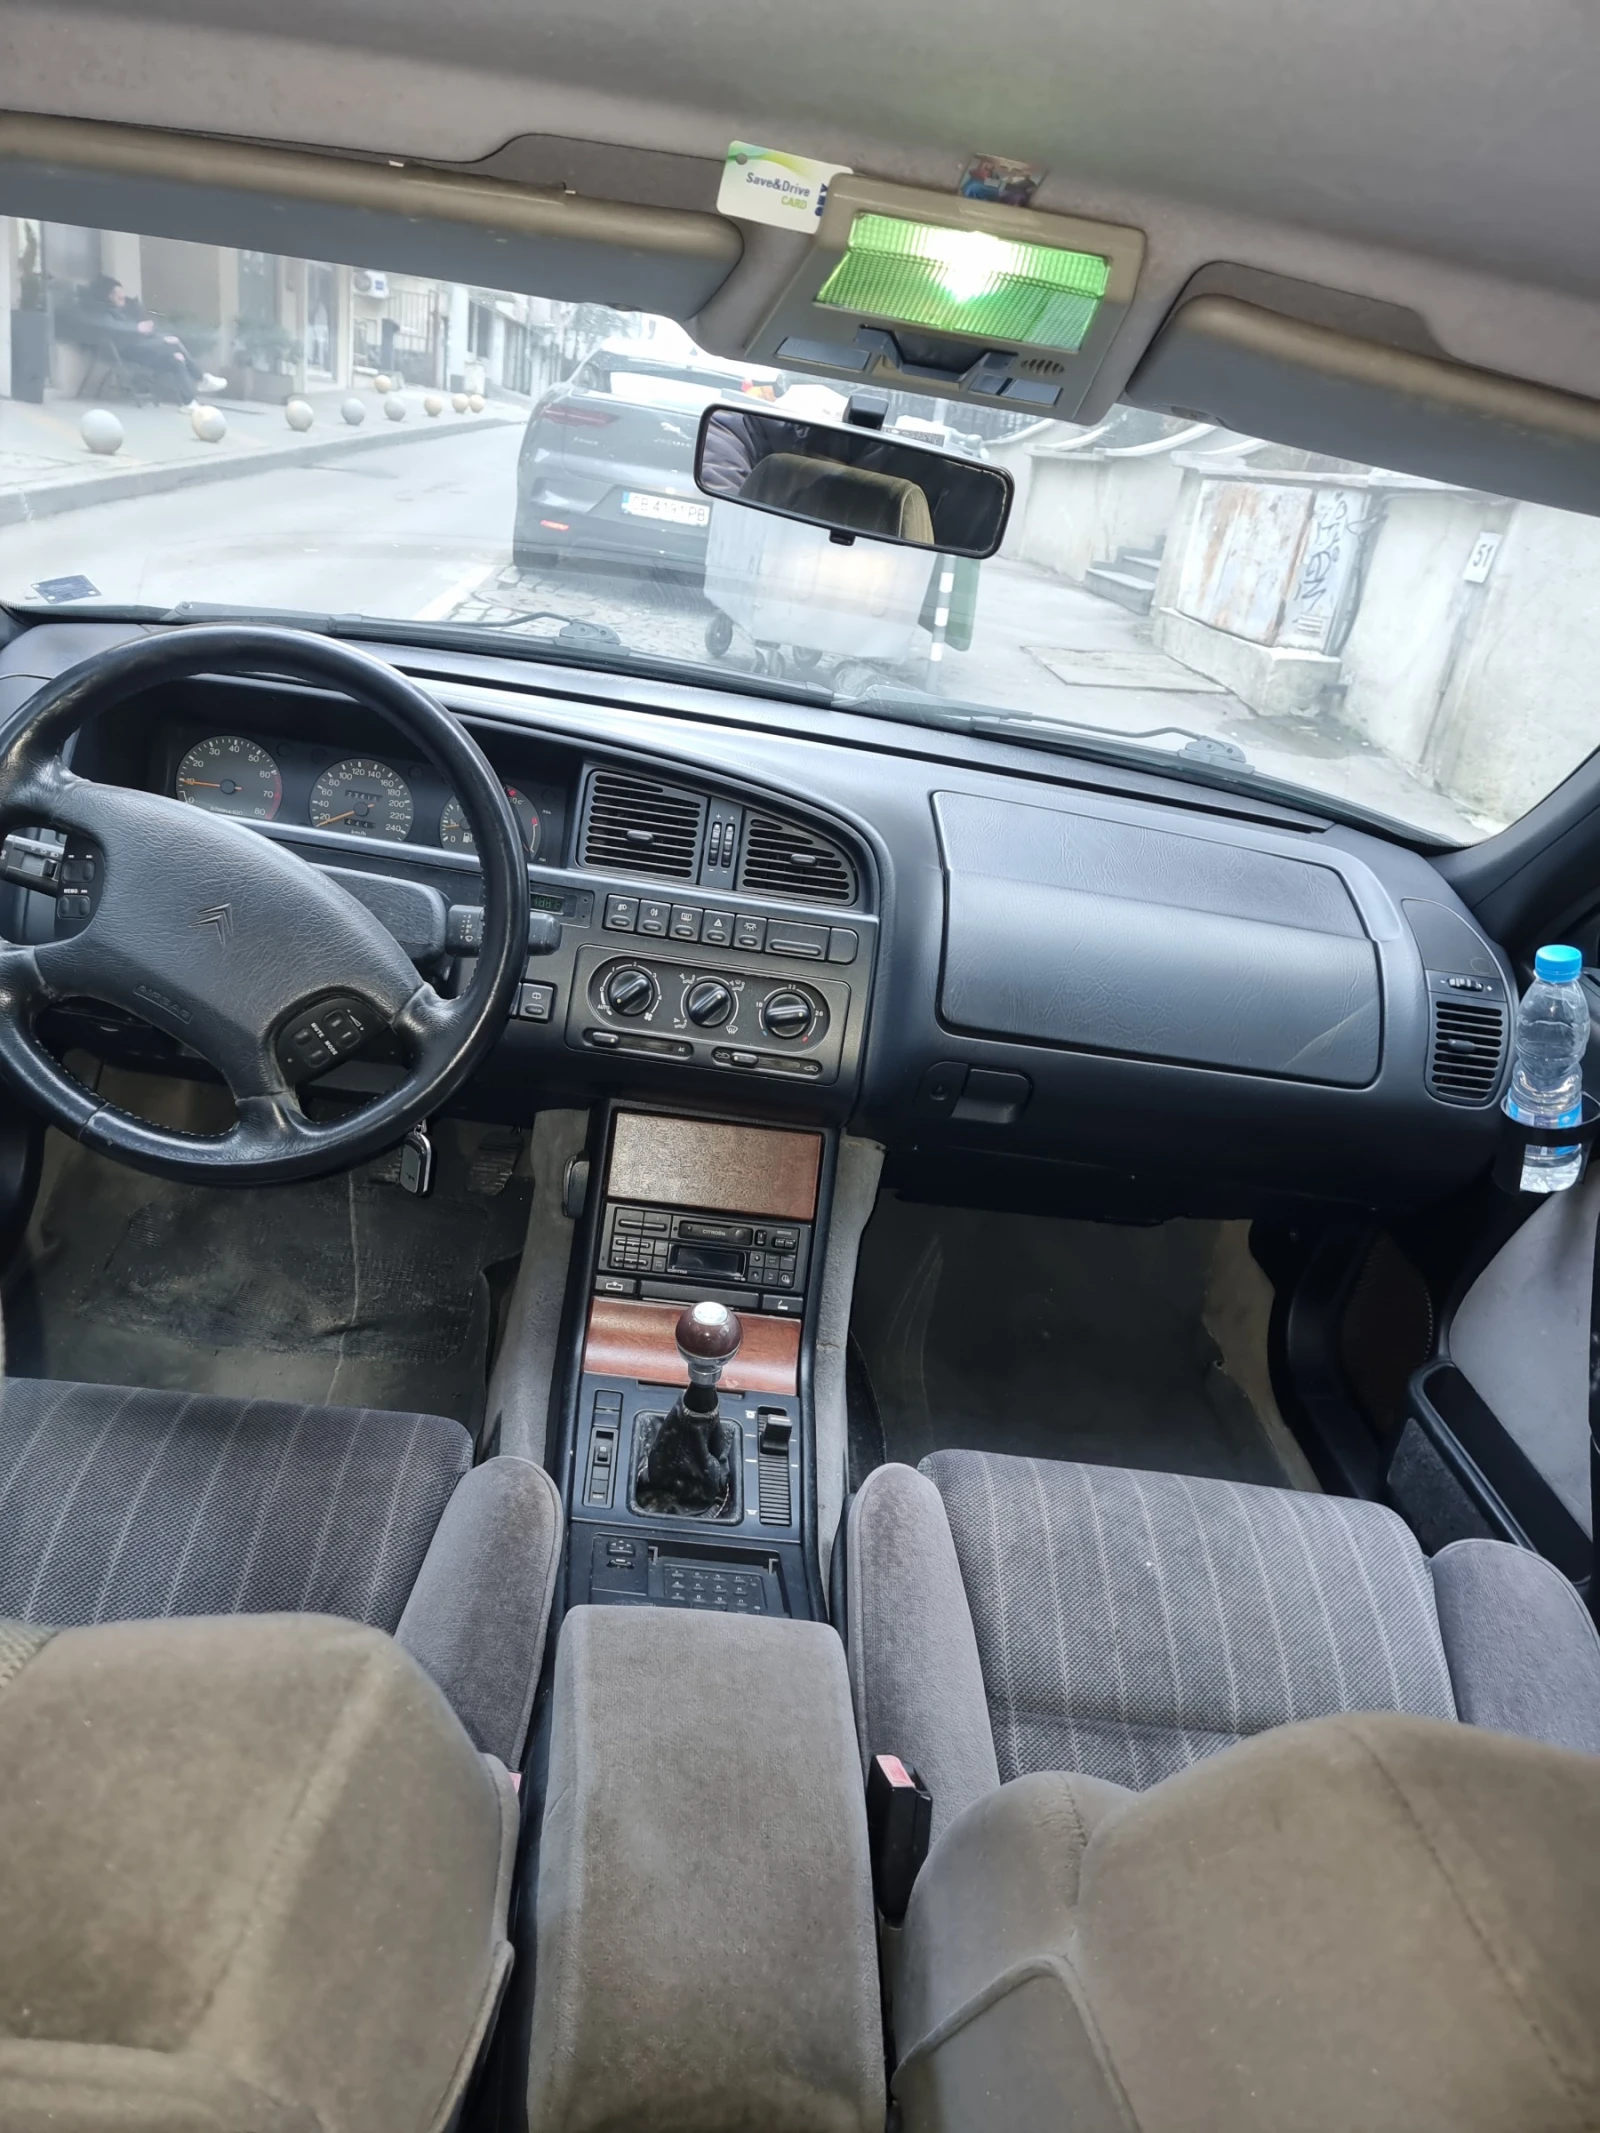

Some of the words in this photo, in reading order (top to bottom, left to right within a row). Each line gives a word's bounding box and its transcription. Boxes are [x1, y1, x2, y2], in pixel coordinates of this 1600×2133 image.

[746, 172, 811, 197] Save&Drive
[781, 195, 808, 210] CARD
[1472, 543, 1494, 569] 51
[209, 748, 220, 756] 30
[229, 745, 240, 753] 40
[248, 754, 260, 763] 50
[192, 760, 204, 768] 20
[259, 771, 271, 779] 60
[339, 772, 353, 780] 100
[352, 768, 365, 776] 120
[367, 770, 381, 779] 140
[328, 779, 340, 787] 80
[380, 779, 394, 788] 160
[263, 790, 274, 799] 70
[321, 789, 333, 797] 60
[387, 788, 401, 797] 180
[188, 796, 195, 804] 0
[318, 800, 330, 808] 40
[388, 799, 405, 808] 200
[254, 808, 266, 816] 80
[389, 812, 405, 820] 220
[385, 823, 401, 832] 240
[451, 835, 456, 843] 0
[310, 1022, 325, 1038] MUTE
[702, 1229, 726, 1237] CITROËN
